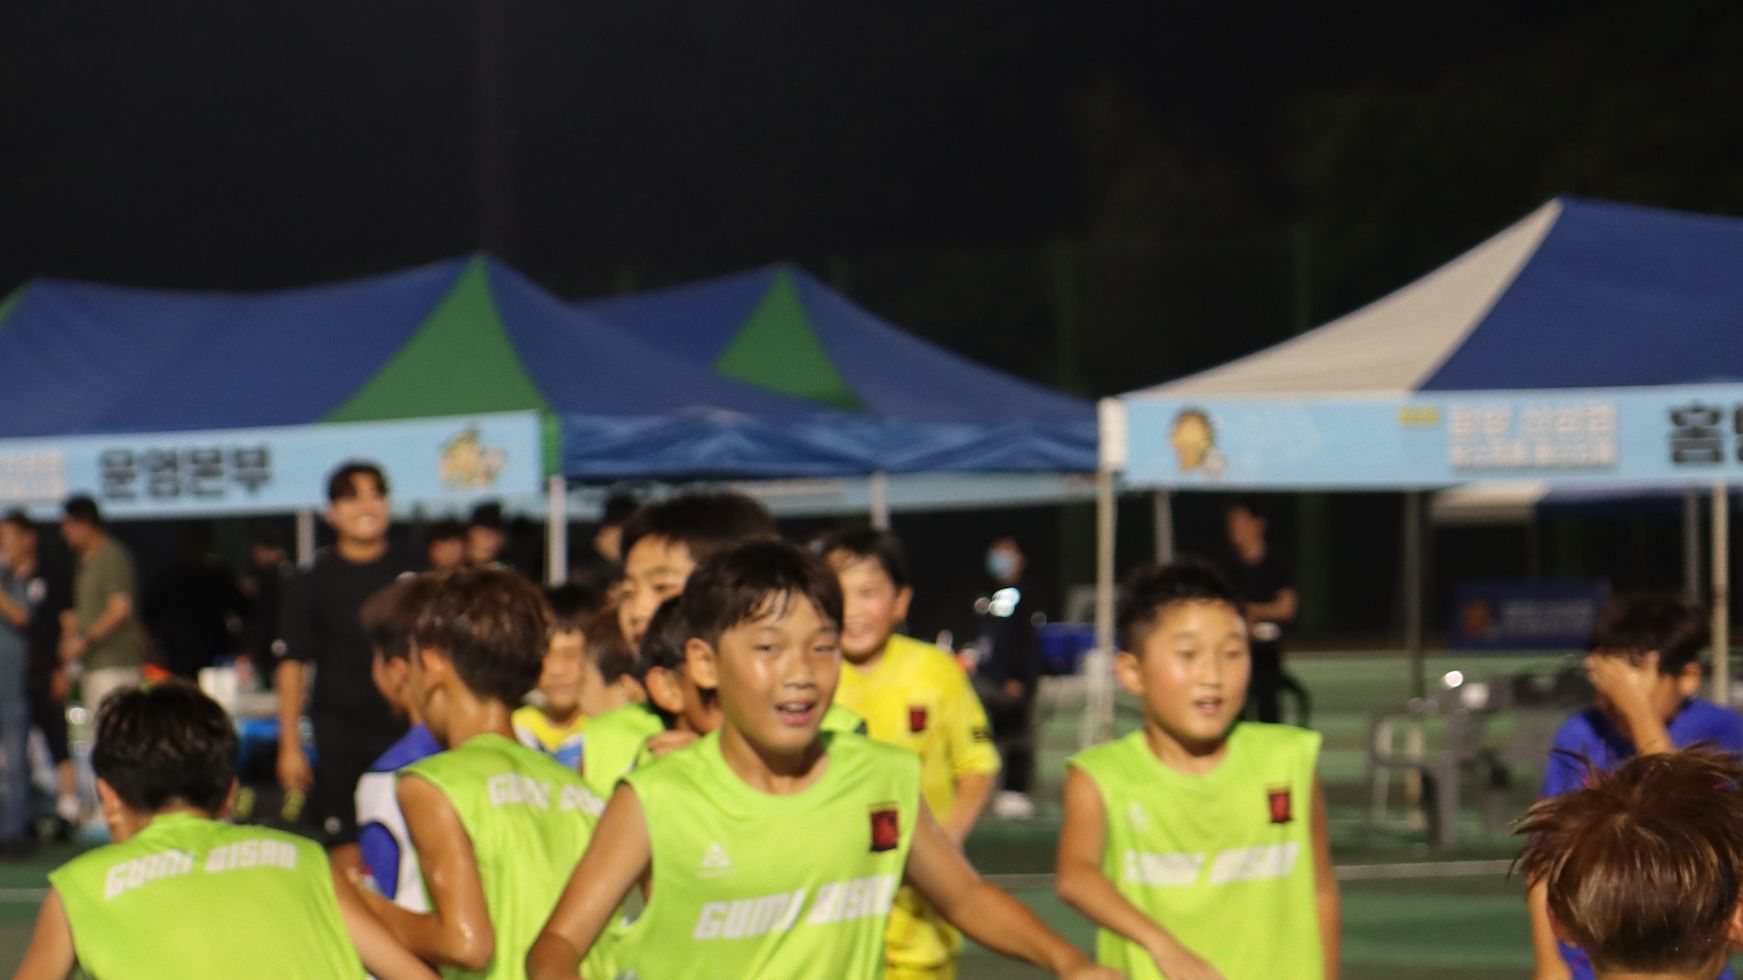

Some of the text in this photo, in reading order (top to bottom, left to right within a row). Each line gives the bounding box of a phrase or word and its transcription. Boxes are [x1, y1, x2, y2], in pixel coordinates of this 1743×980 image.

[1668, 398, 1743, 466] 홈
[98, 446, 272, 500] 운영본부
[694, 887, 806, 939] GUMI
